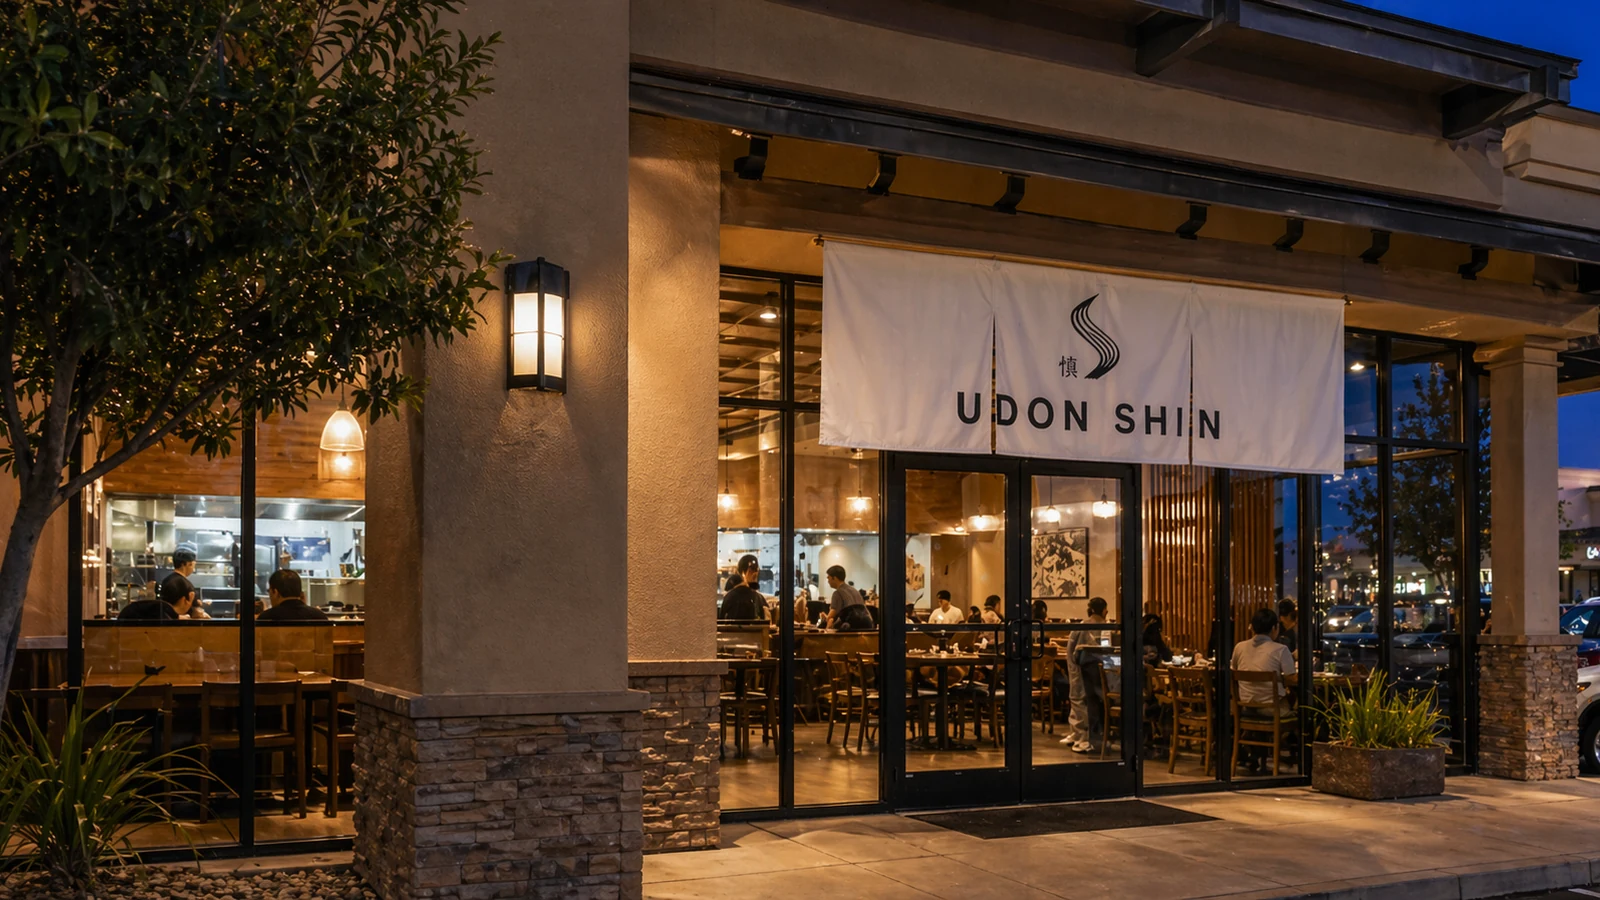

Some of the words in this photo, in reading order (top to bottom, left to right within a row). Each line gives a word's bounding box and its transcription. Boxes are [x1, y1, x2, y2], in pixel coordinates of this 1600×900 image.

[1058, 355, 1078, 378] 慎
[957, 391, 1088, 432] UDON
[1114, 402, 1220, 439] SHIN
